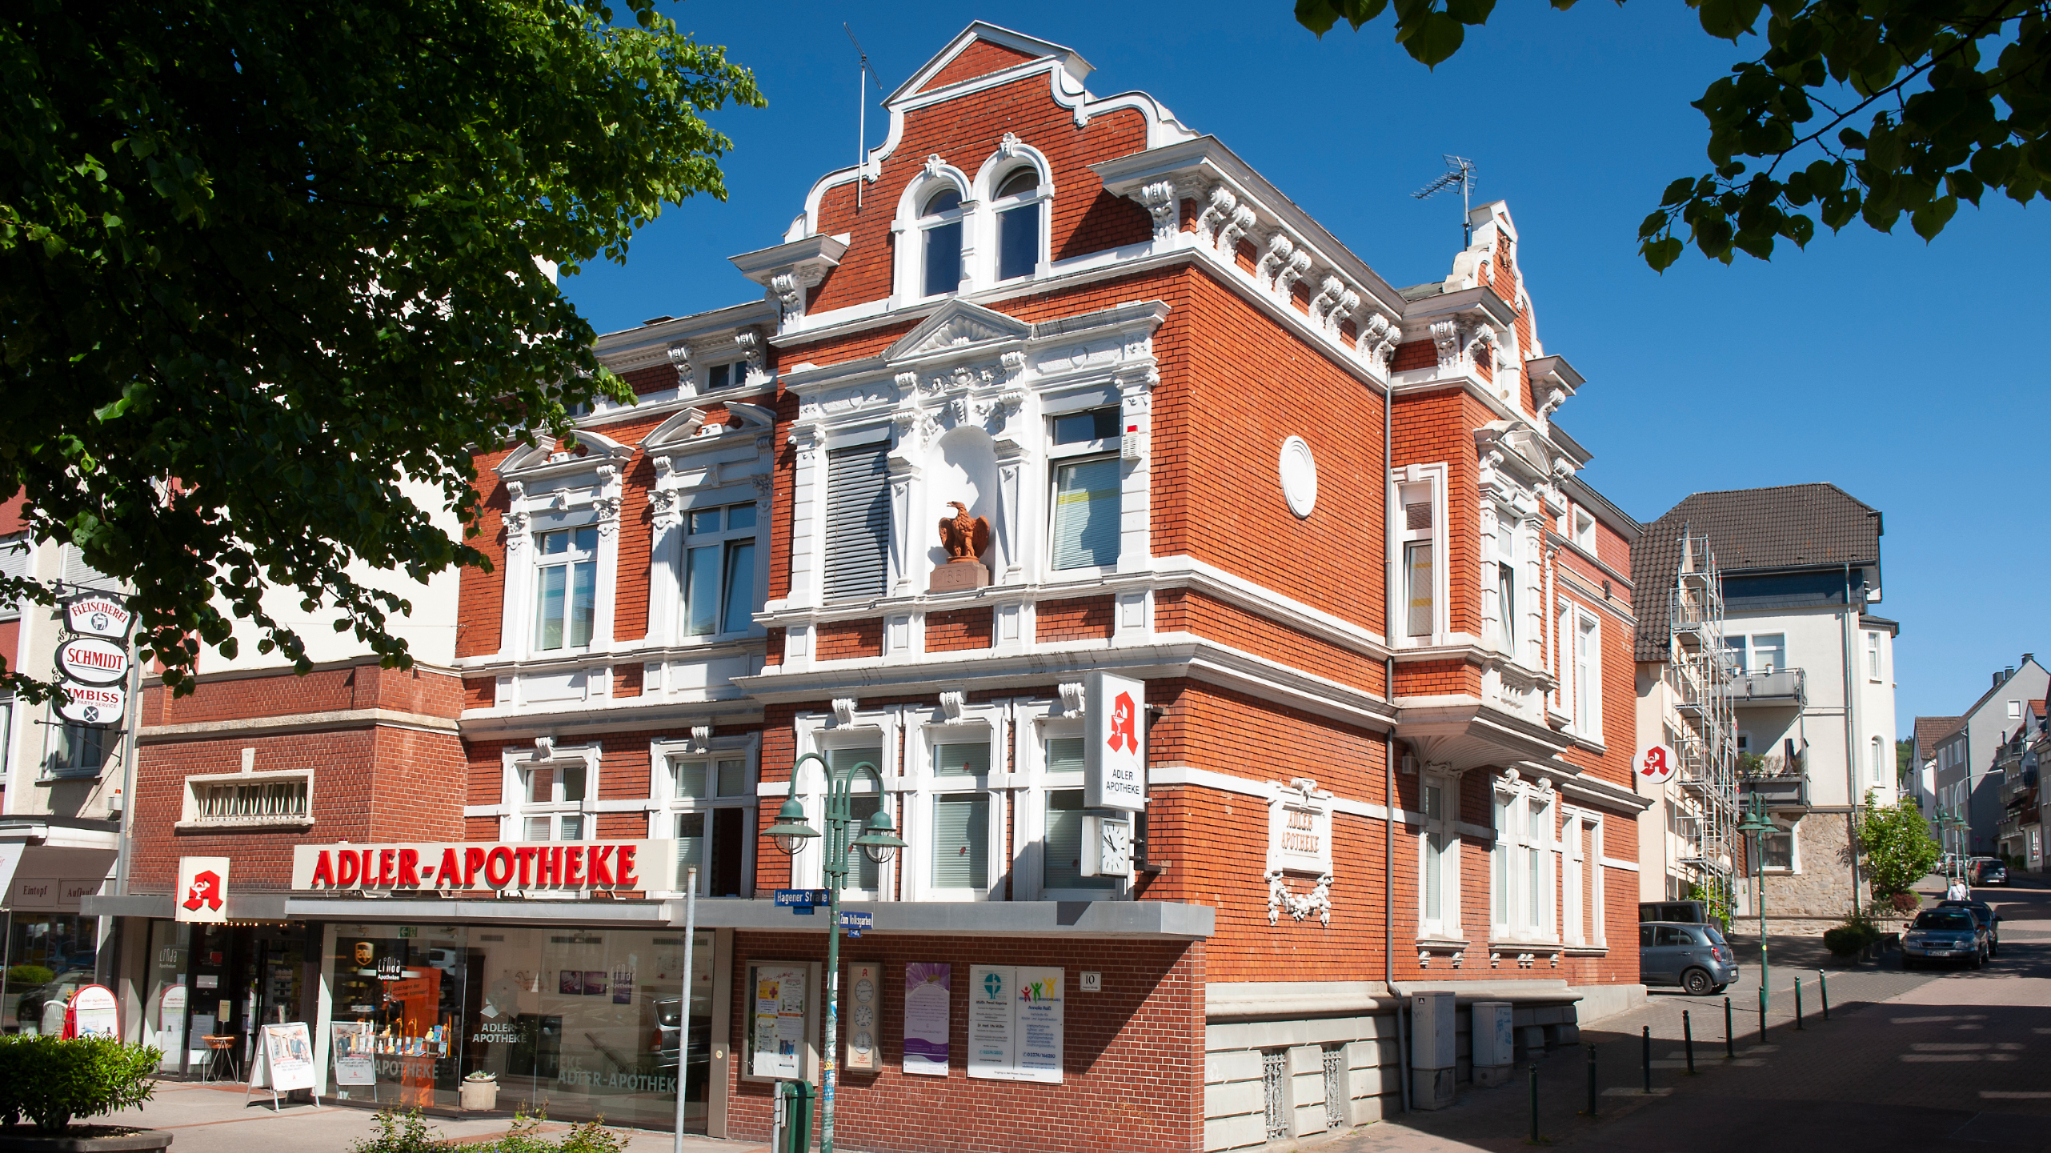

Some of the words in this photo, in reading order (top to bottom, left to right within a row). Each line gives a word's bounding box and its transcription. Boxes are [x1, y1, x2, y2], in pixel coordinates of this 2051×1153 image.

[71, 601, 129, 624] FLEISCHEREI
[67, 647, 124, 670] SCHMIDT
[68, 687, 119, 703] IMBISS
[1112, 768, 1134, 780] ADLER
[1106, 781, 1140, 795] APOTHEKE
[1287, 811, 1313, 831] ADLER
[1281, 832, 1320, 853] APOTHEKE
[311, 845, 639, 889] ADLER-APOTHEKE
[23, 885, 48, 897] Eintopf
[777, 891, 803, 904] Hagener
[472, 1033, 528, 1043] APOTHEKE
